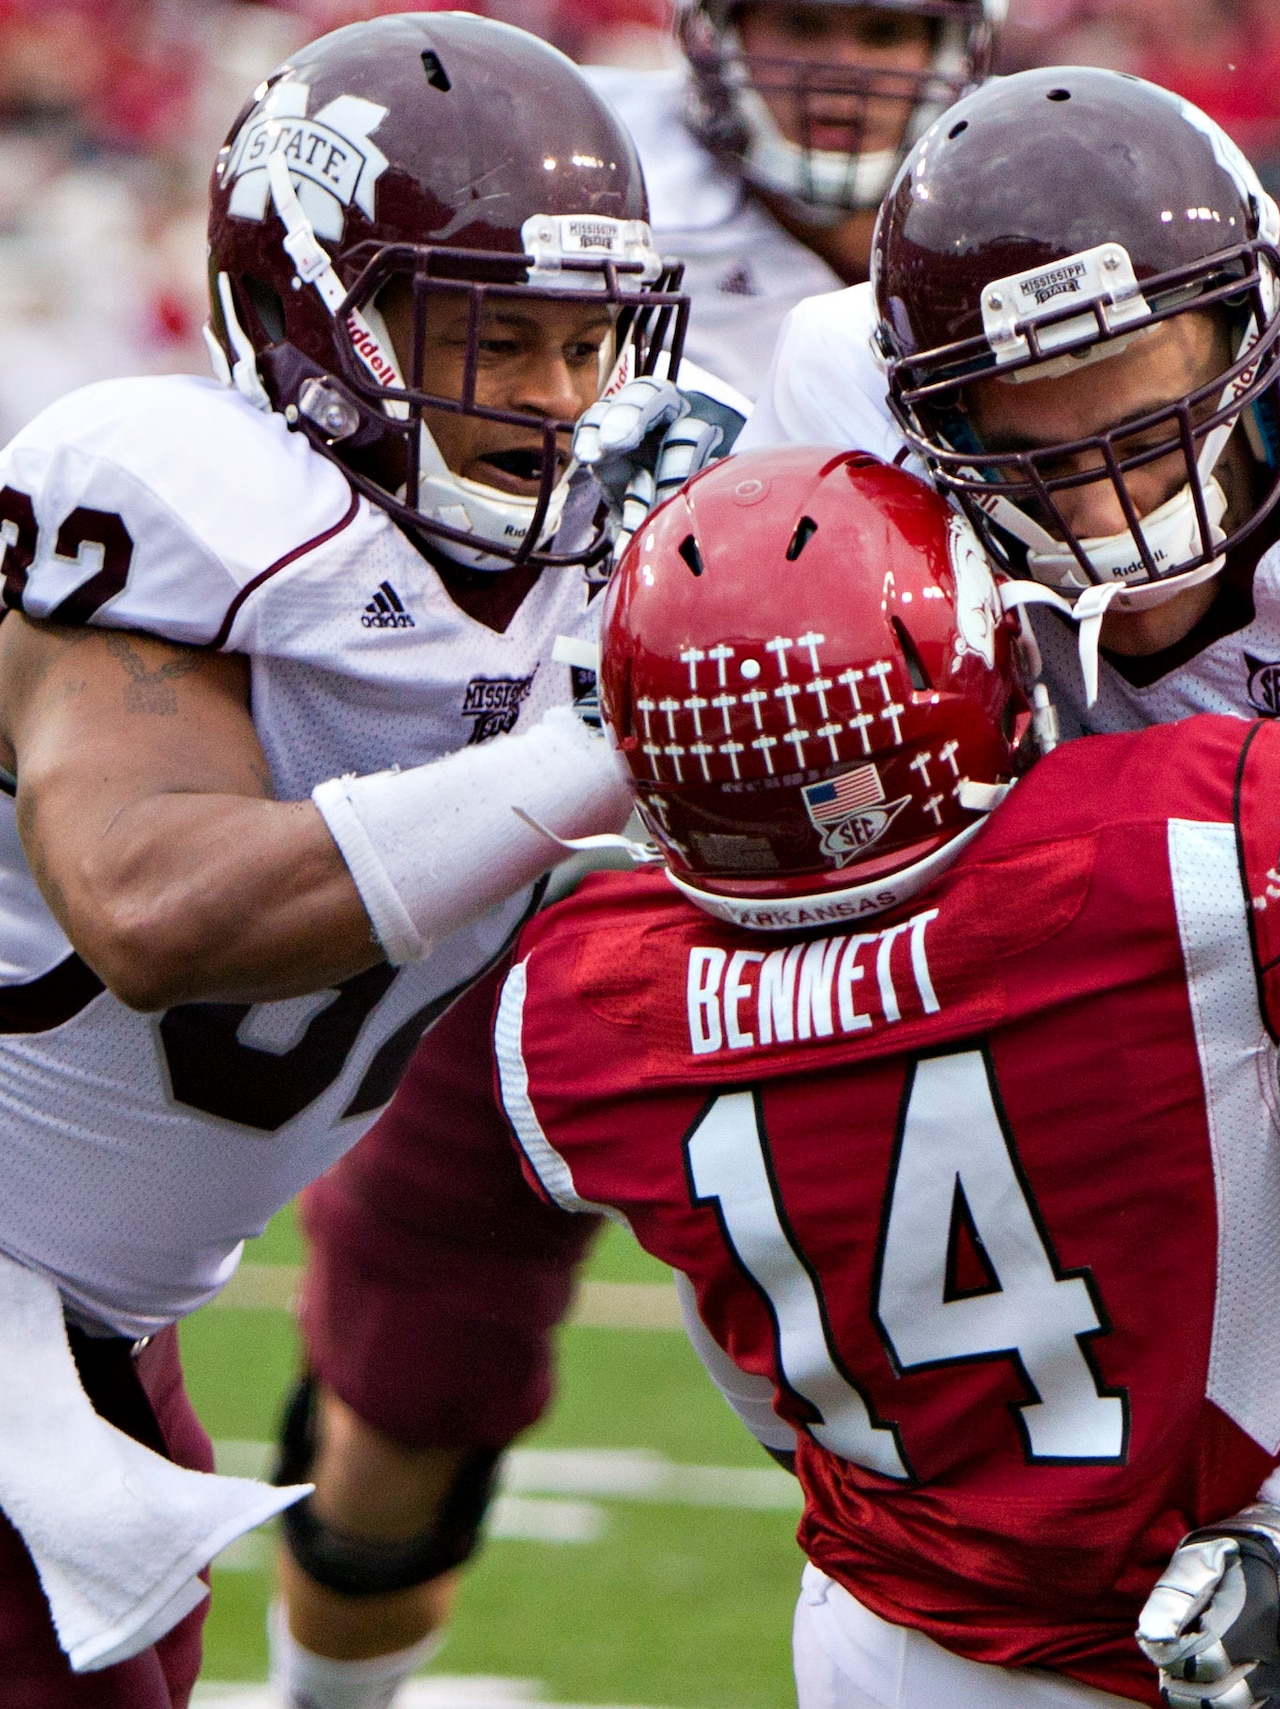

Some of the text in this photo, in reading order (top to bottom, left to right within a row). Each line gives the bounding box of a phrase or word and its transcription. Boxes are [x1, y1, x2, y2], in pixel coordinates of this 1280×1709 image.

[250, 125, 346, 184] STATE
[1021, 263, 1086, 294] MISSISSIPPI
[361, 612, 415, 628] adidas
[839, 817, 875, 846] SEC
[740, 891, 897, 926] ARKANSAS
[687, 908, 941, 1055] BENNETT
[682, 1042, 1130, 1483] 14
